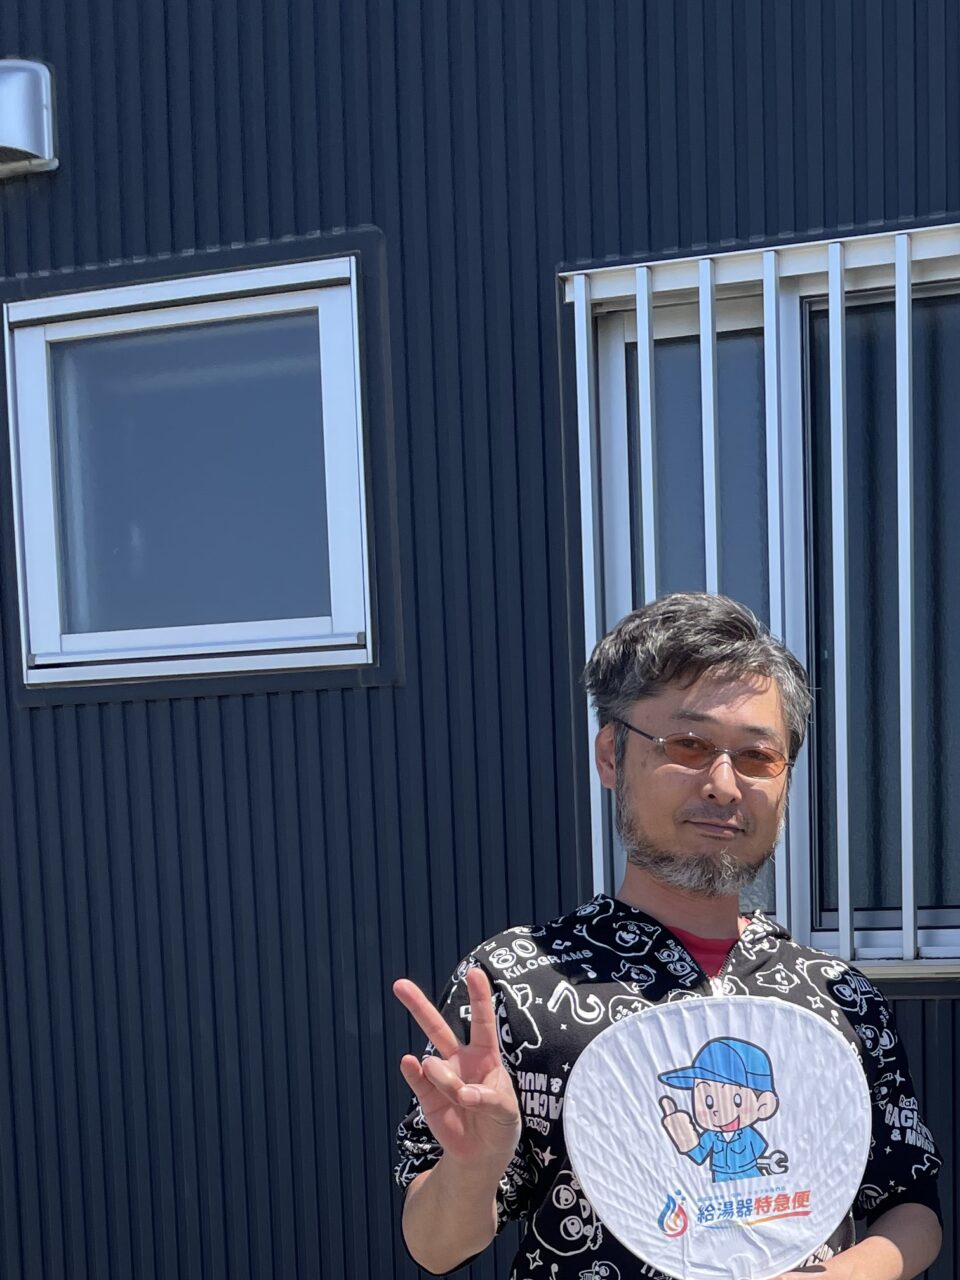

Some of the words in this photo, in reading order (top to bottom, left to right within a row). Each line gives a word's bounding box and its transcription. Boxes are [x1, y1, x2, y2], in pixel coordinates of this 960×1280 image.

[489, 938, 537, 968] 80
[503, 950, 593, 979] KILOGRAMS
[697, 1190, 811, 1224] 給湯器特急便
